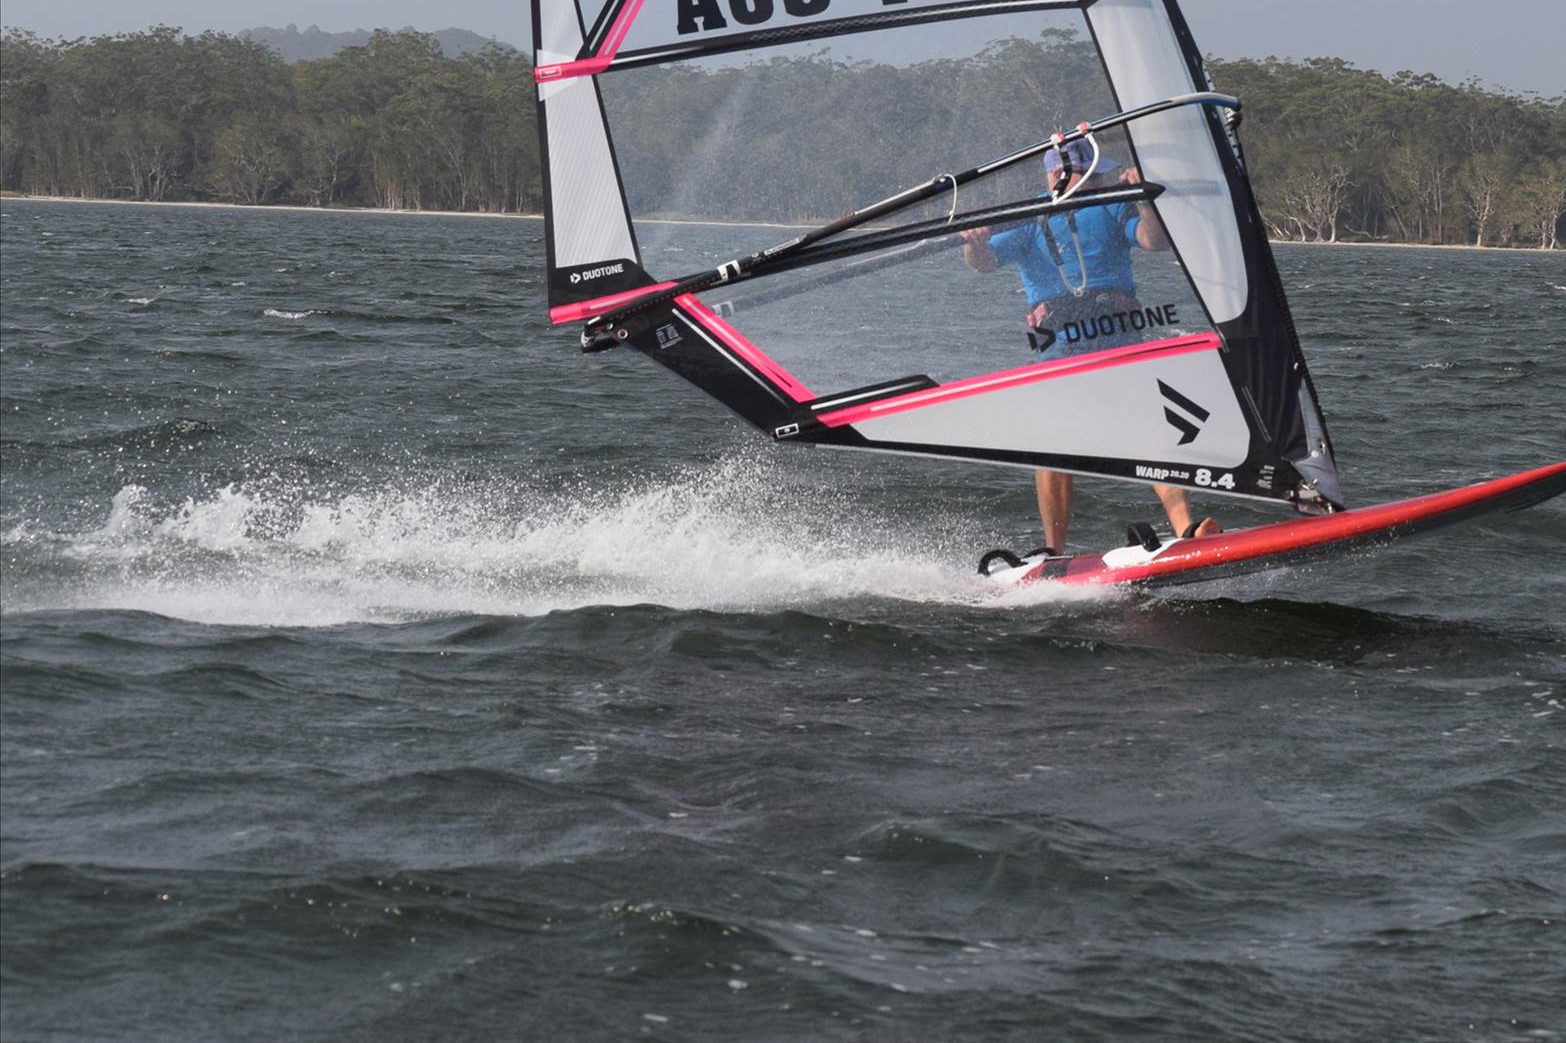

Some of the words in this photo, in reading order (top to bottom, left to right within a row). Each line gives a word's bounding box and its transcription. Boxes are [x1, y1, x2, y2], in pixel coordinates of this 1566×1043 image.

[582, 263, 624, 281] DUOTONE
[1063, 304, 1180, 343] DUOTONE
[1135, 465, 1169, 480] WARP
[1194, 468, 1236, 490] 8.4
